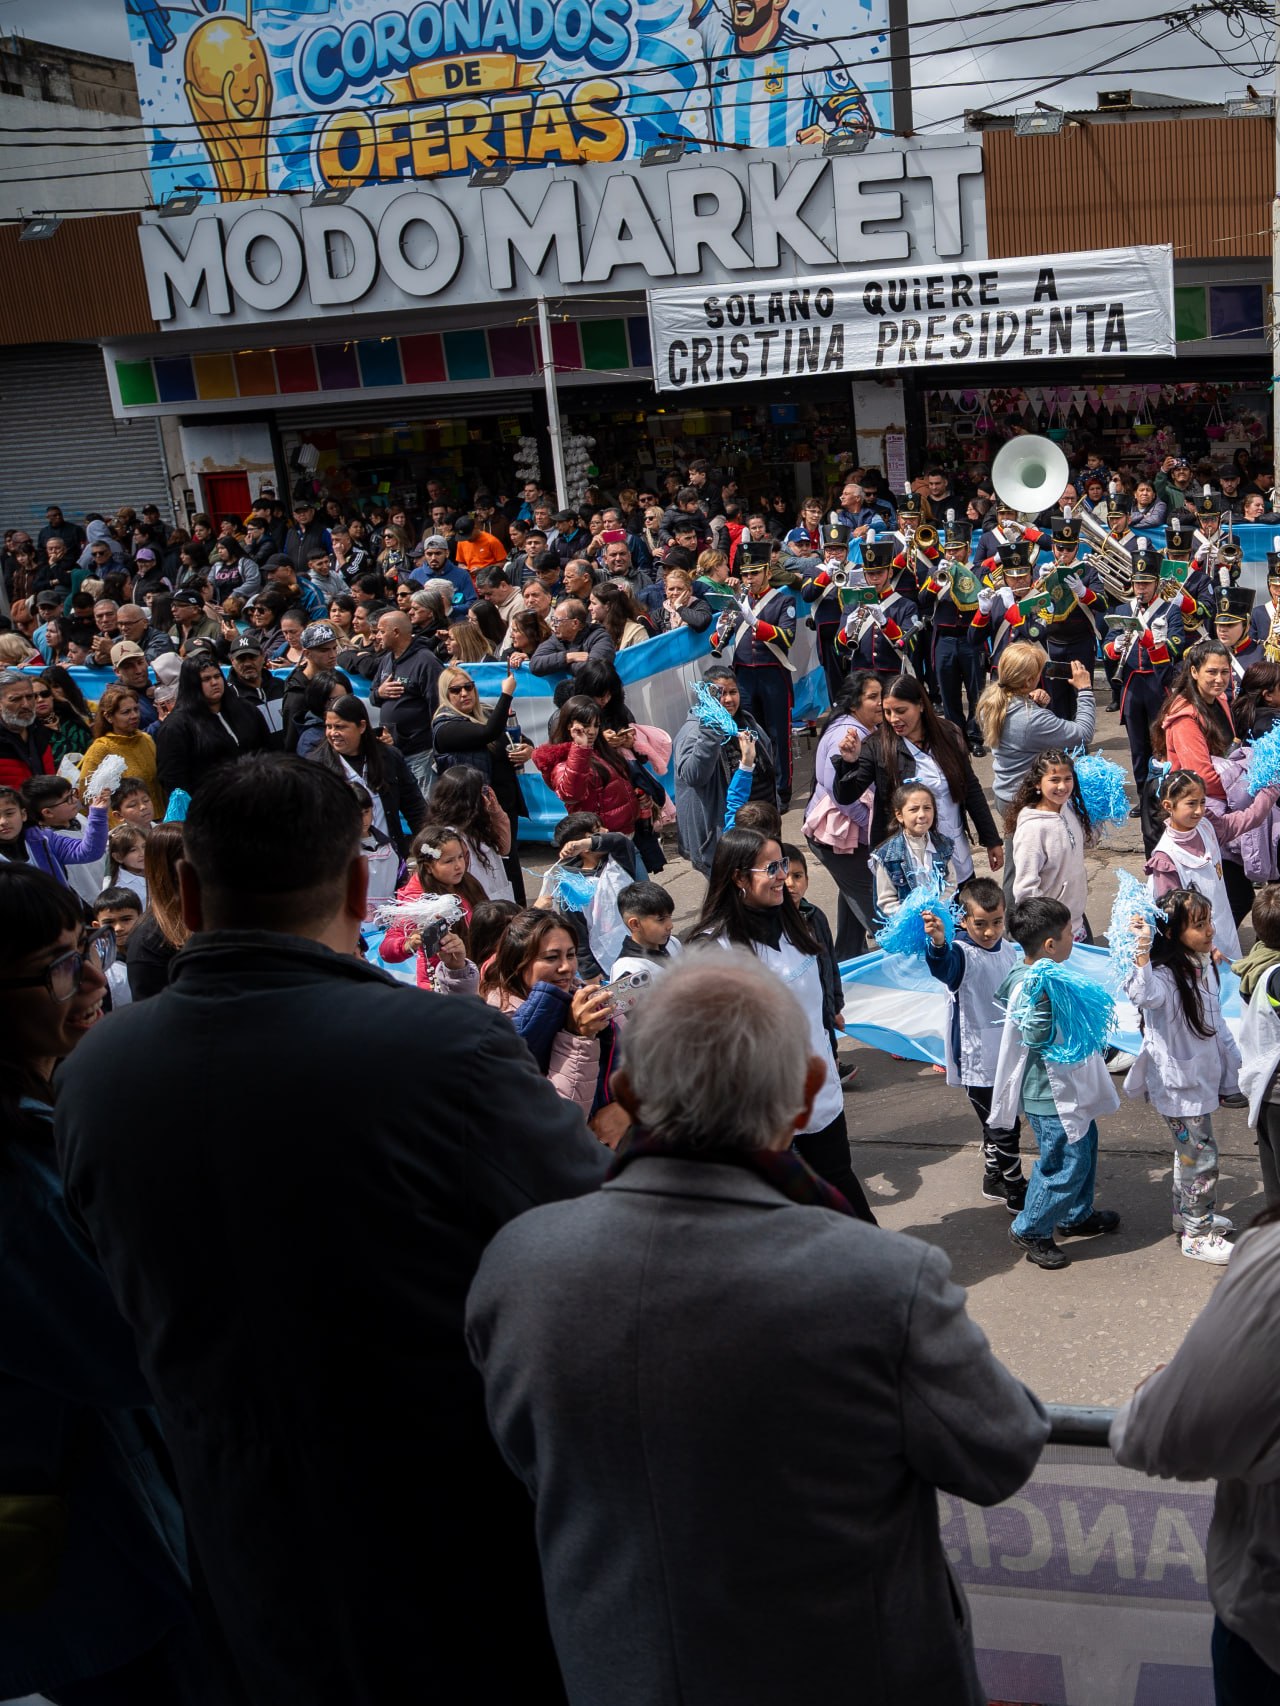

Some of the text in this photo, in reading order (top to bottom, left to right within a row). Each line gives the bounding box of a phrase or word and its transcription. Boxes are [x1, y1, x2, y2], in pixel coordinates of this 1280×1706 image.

[302, 0, 629, 97] CORONADOS
[444, 61, 482, 90] DE
[318, 78, 627, 191] OFERTAS
[137, 144, 984, 321] MODO MARKET
[706, 287, 834, 329] SOLANO
[1033, 268, 1058, 302] A
[668, 302, 1129, 387] CRISTINA PRESIDENTA
